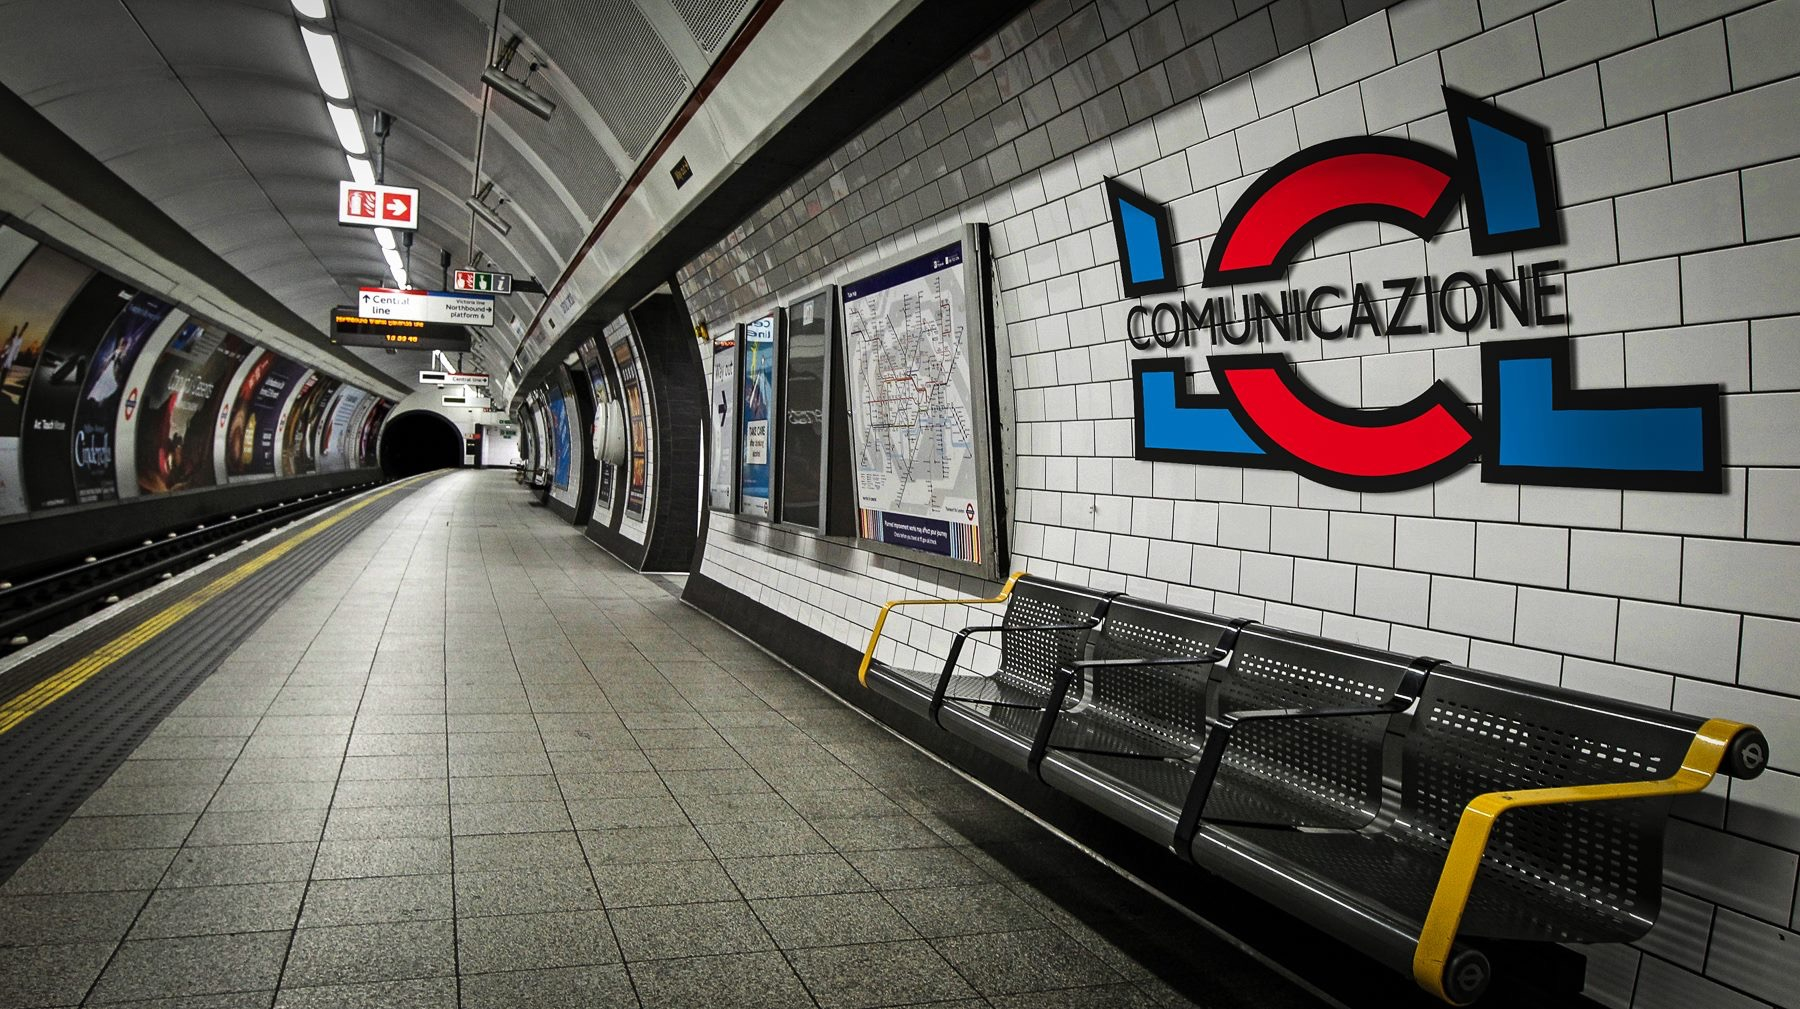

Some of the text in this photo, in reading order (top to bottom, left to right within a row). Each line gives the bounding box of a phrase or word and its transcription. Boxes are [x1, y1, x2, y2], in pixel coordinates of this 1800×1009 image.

[372, 295, 409, 305] Central
[372, 306, 391, 315] line
[445, 304, 486, 312] Northbound
[1127, 260, 1567, 351] COMUNICAZIONE
[725, 359, 734, 377] out
